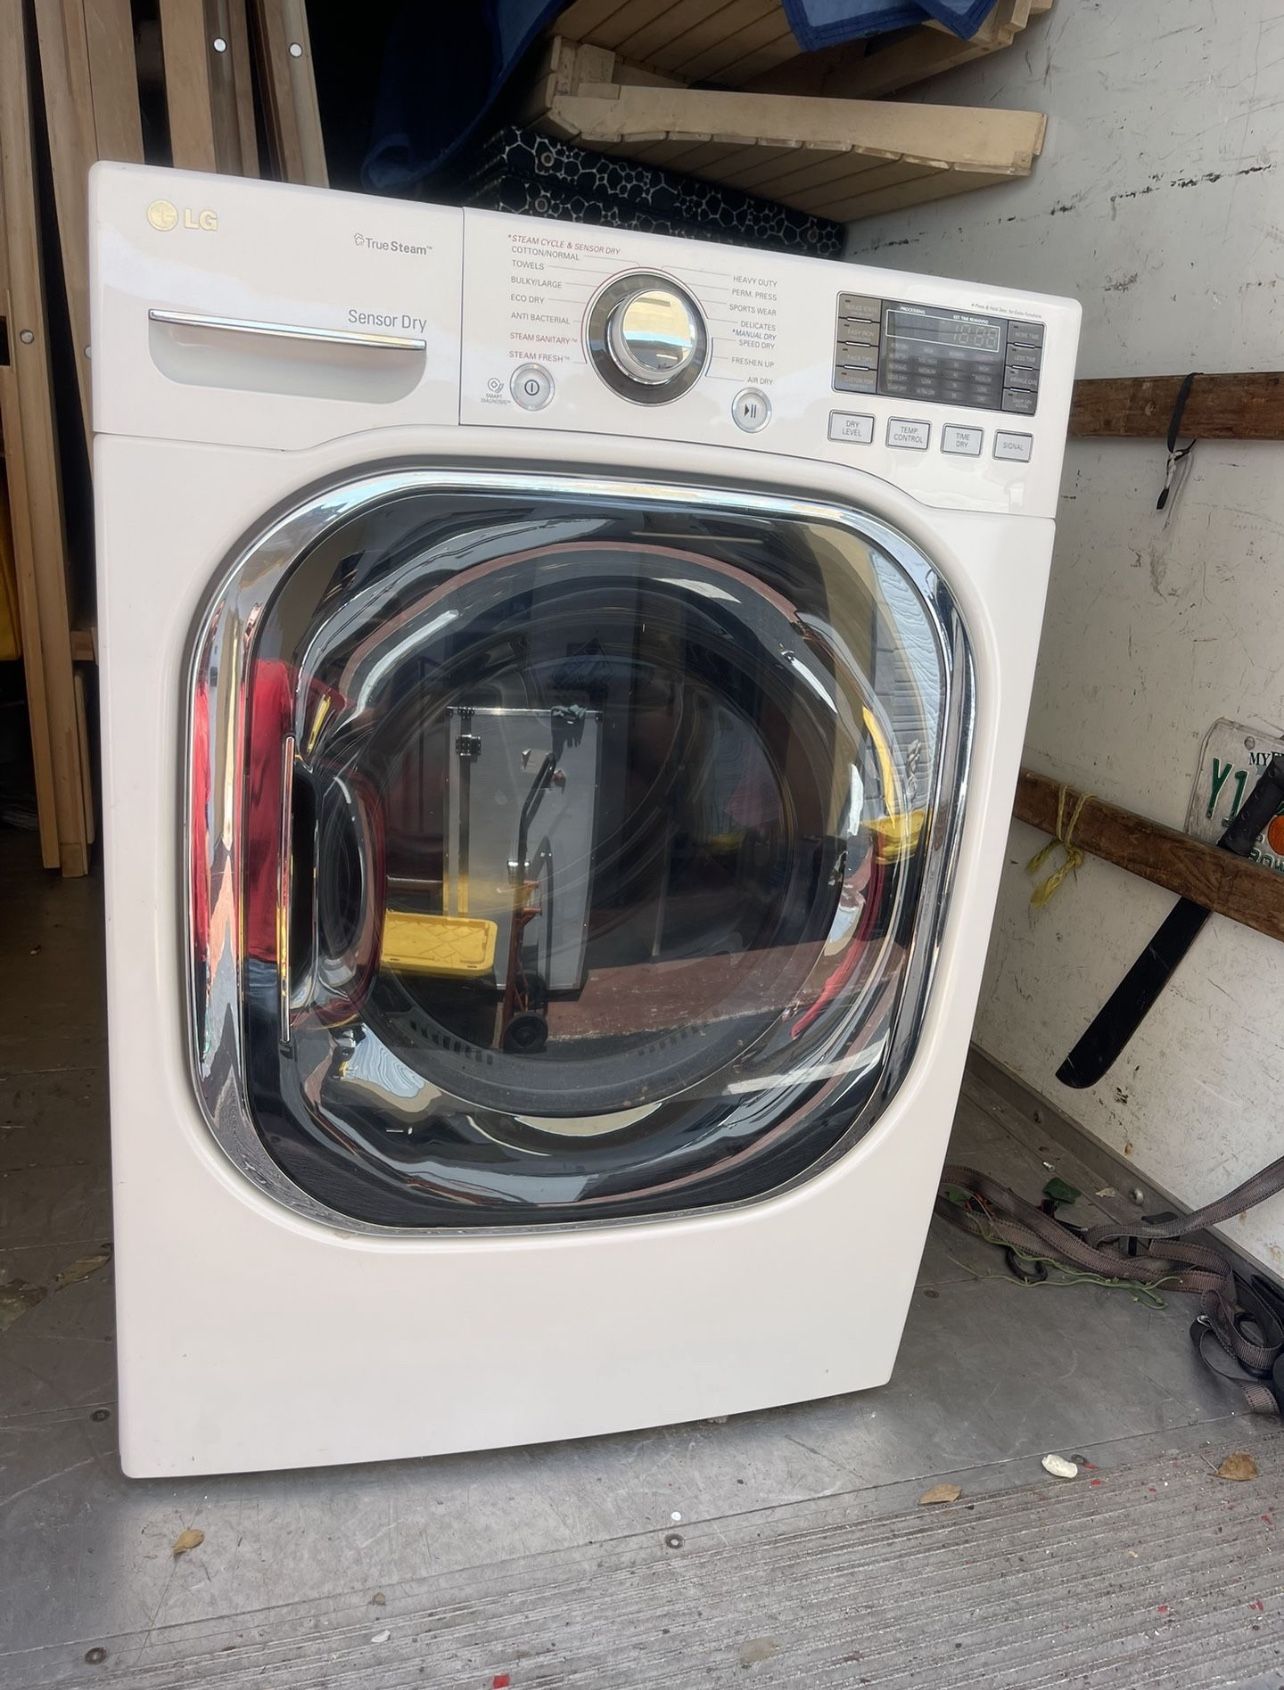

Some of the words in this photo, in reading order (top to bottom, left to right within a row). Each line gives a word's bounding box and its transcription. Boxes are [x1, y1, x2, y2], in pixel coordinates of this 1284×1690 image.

[183, 207, 219, 231] LG
[511, 245, 580, 261] COTTON/NORMAL
[541, 238, 565, 249] CYCLE
[566, 242, 573, 250] &
[574, 243, 605, 254] SENSOR
[605, 247, 621, 256] DRY
[511, 259, 545, 271] TOWELS
[510, 276, 563, 289] BULKY/LARGE
[733, 275, 757, 286] HEAVY
[758, 278, 778, 288] DUTY
[510, 294, 528, 303] ECO
[528, 295, 546, 305] DRY
[755, 291, 777, 302] PRESS
[729, 303, 756, 314] SPORTS
[757, 307, 777, 317] WEAR
[347, 308, 399, 329] Sensor
[401, 314, 428, 333] Dry
[510, 312, 529, 321] ANTI
[530, 313, 571, 325] BACTERIAL
[740, 320, 777, 332] DELICATES
[510, 332, 535, 342] STEAM
[763, 333, 777, 342] DRY
[738, 339, 761, 349] SPEED
[761, 341, 775, 350] DRY
[508, 350, 537, 361] STEAM
[731, 356, 764, 367] FRESHEN
[764, 360, 775, 369] UP
[747, 376, 759, 385] AIR
[759, 377, 774, 386] DRY
[845, 419, 860, 429] DRY
[841, 427, 862, 438] LEVEL
[955, 432, 971, 442] TIME
[893, 433, 924, 445] CONTROL
[955, 439, 969, 449] DRY
[1002, 441, 1025, 452] SIGNAL
[1206, 757, 1254, 832] Y1
